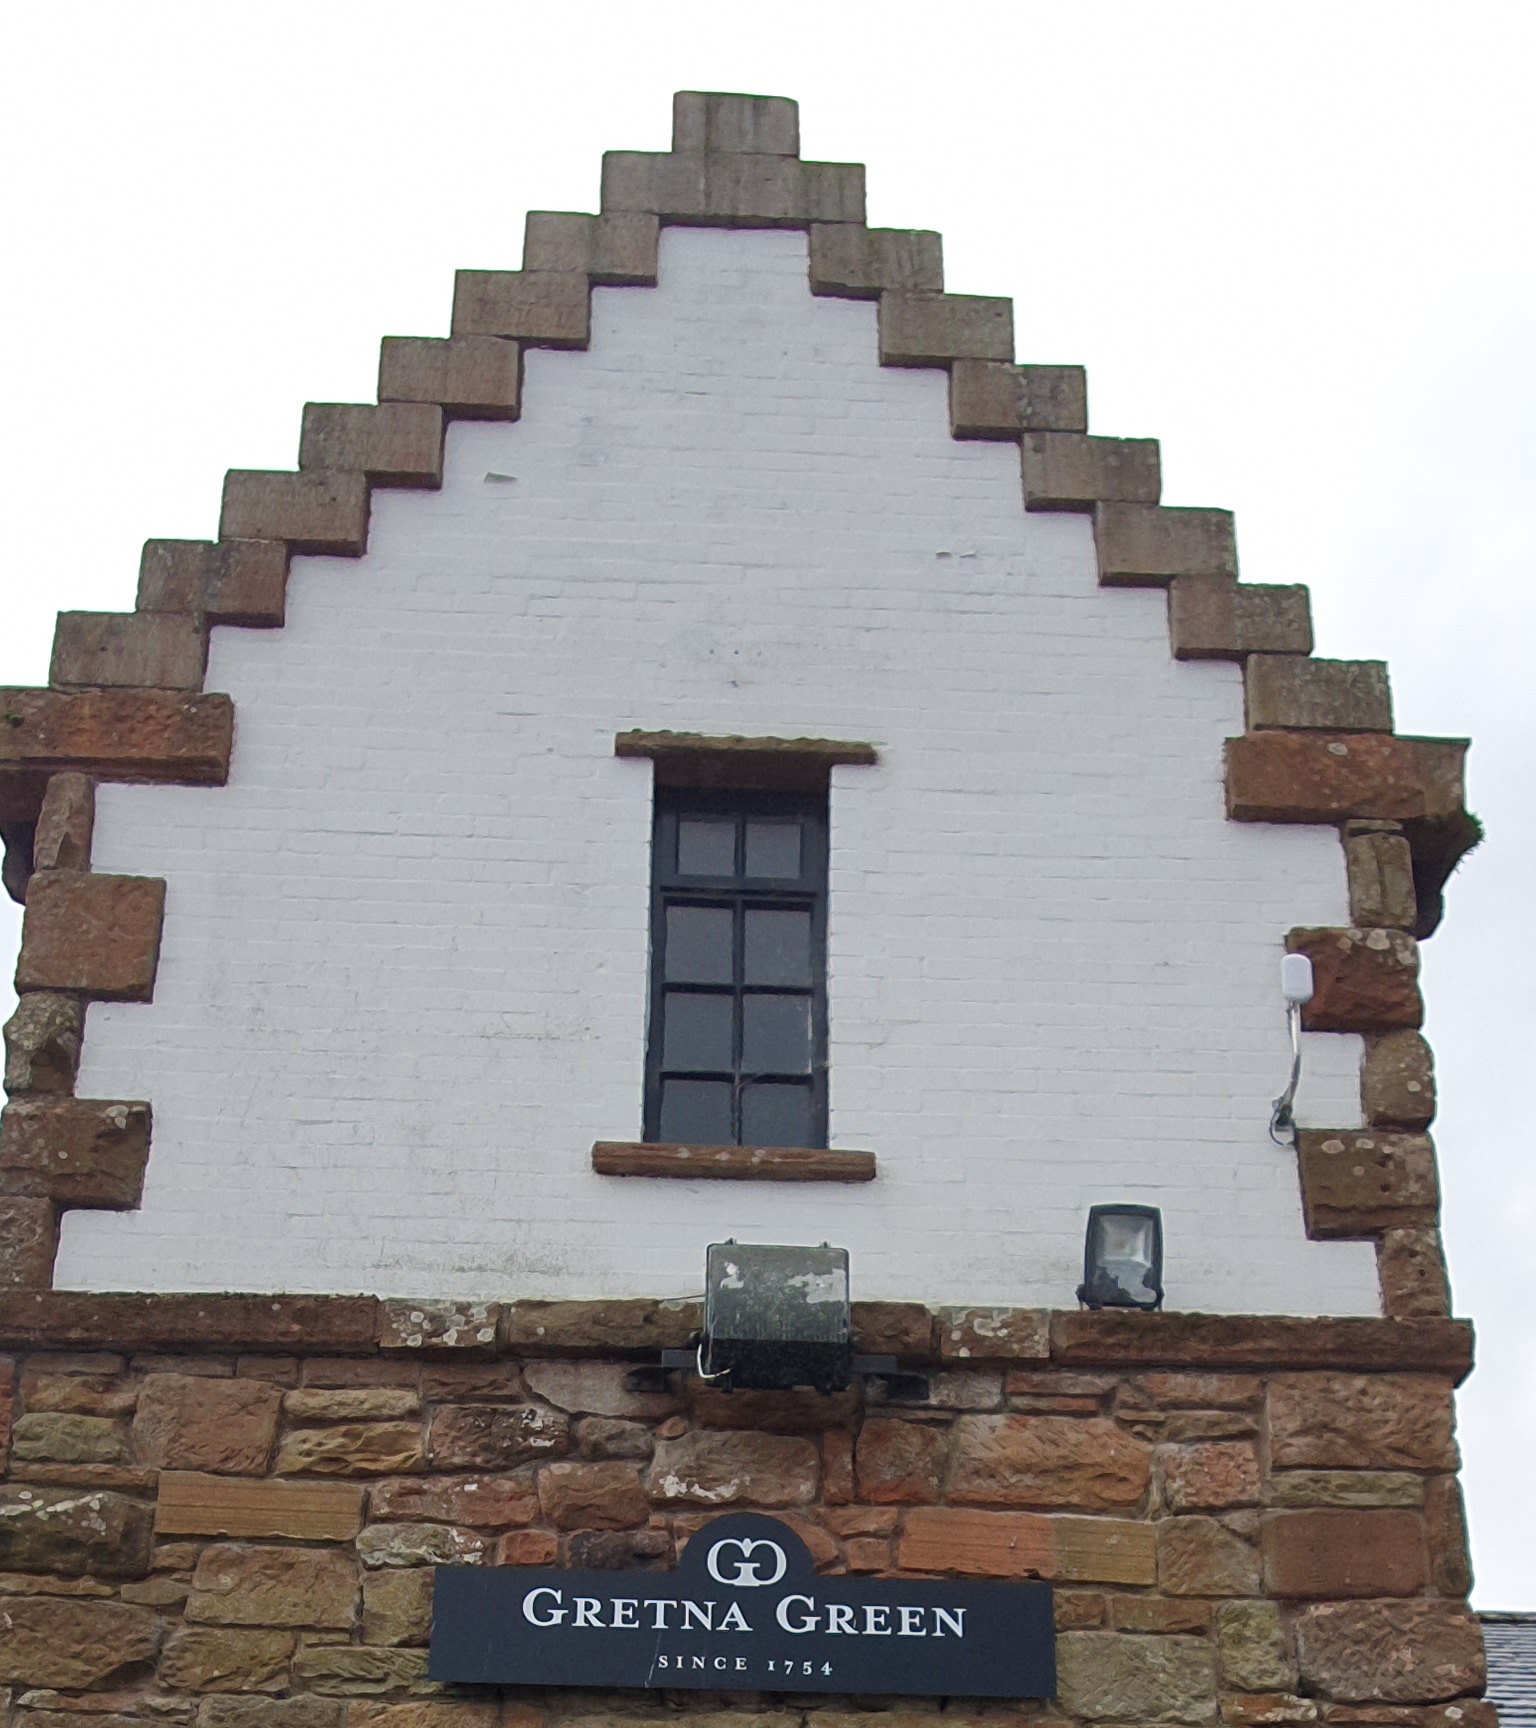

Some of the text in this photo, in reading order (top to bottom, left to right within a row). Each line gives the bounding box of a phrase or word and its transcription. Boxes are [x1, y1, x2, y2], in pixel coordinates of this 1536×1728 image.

[522, 1587, 967, 1638] GRETNA GREEN
[658, 1655, 833, 1676] SINCE 1754
